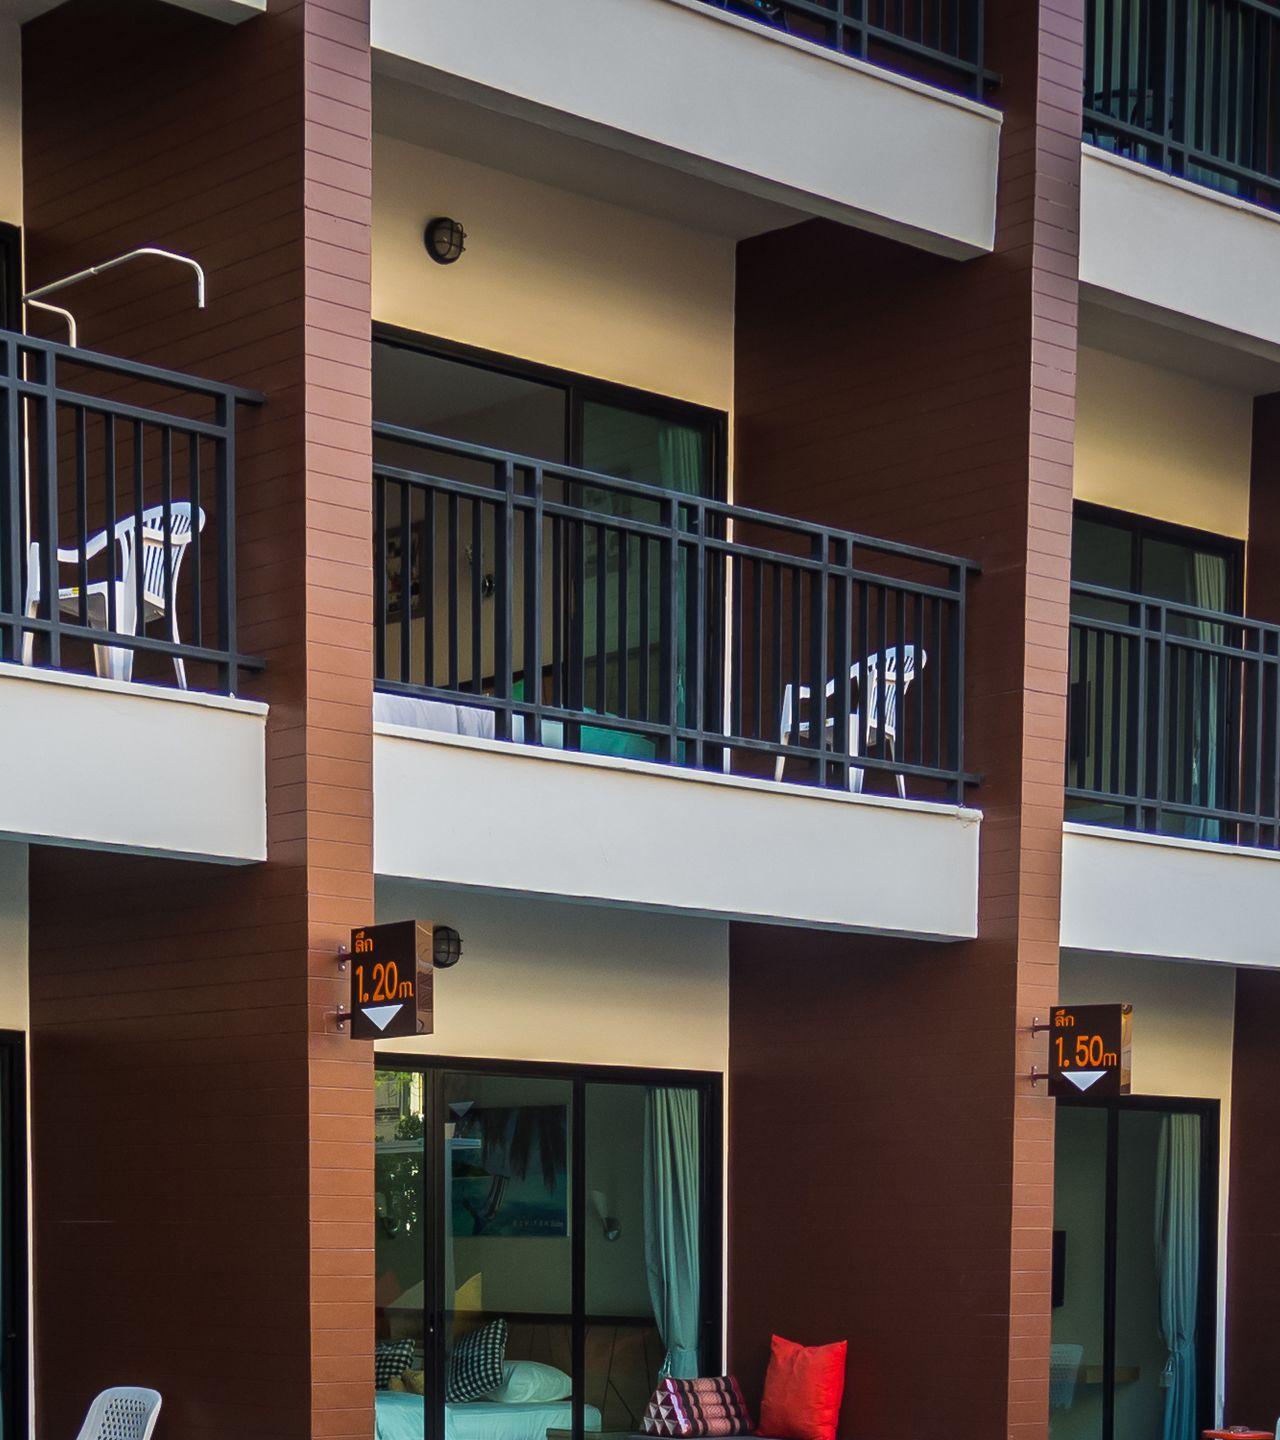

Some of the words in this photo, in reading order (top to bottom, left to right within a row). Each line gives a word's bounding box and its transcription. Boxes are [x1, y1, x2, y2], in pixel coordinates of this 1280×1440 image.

[355, 931, 374, 953] ลึก
[356, 961, 414, 1003] 1.20m
[1055, 1009, 1074, 1028] ลึก
[1055, 1035, 1117, 1067] 1.50m
